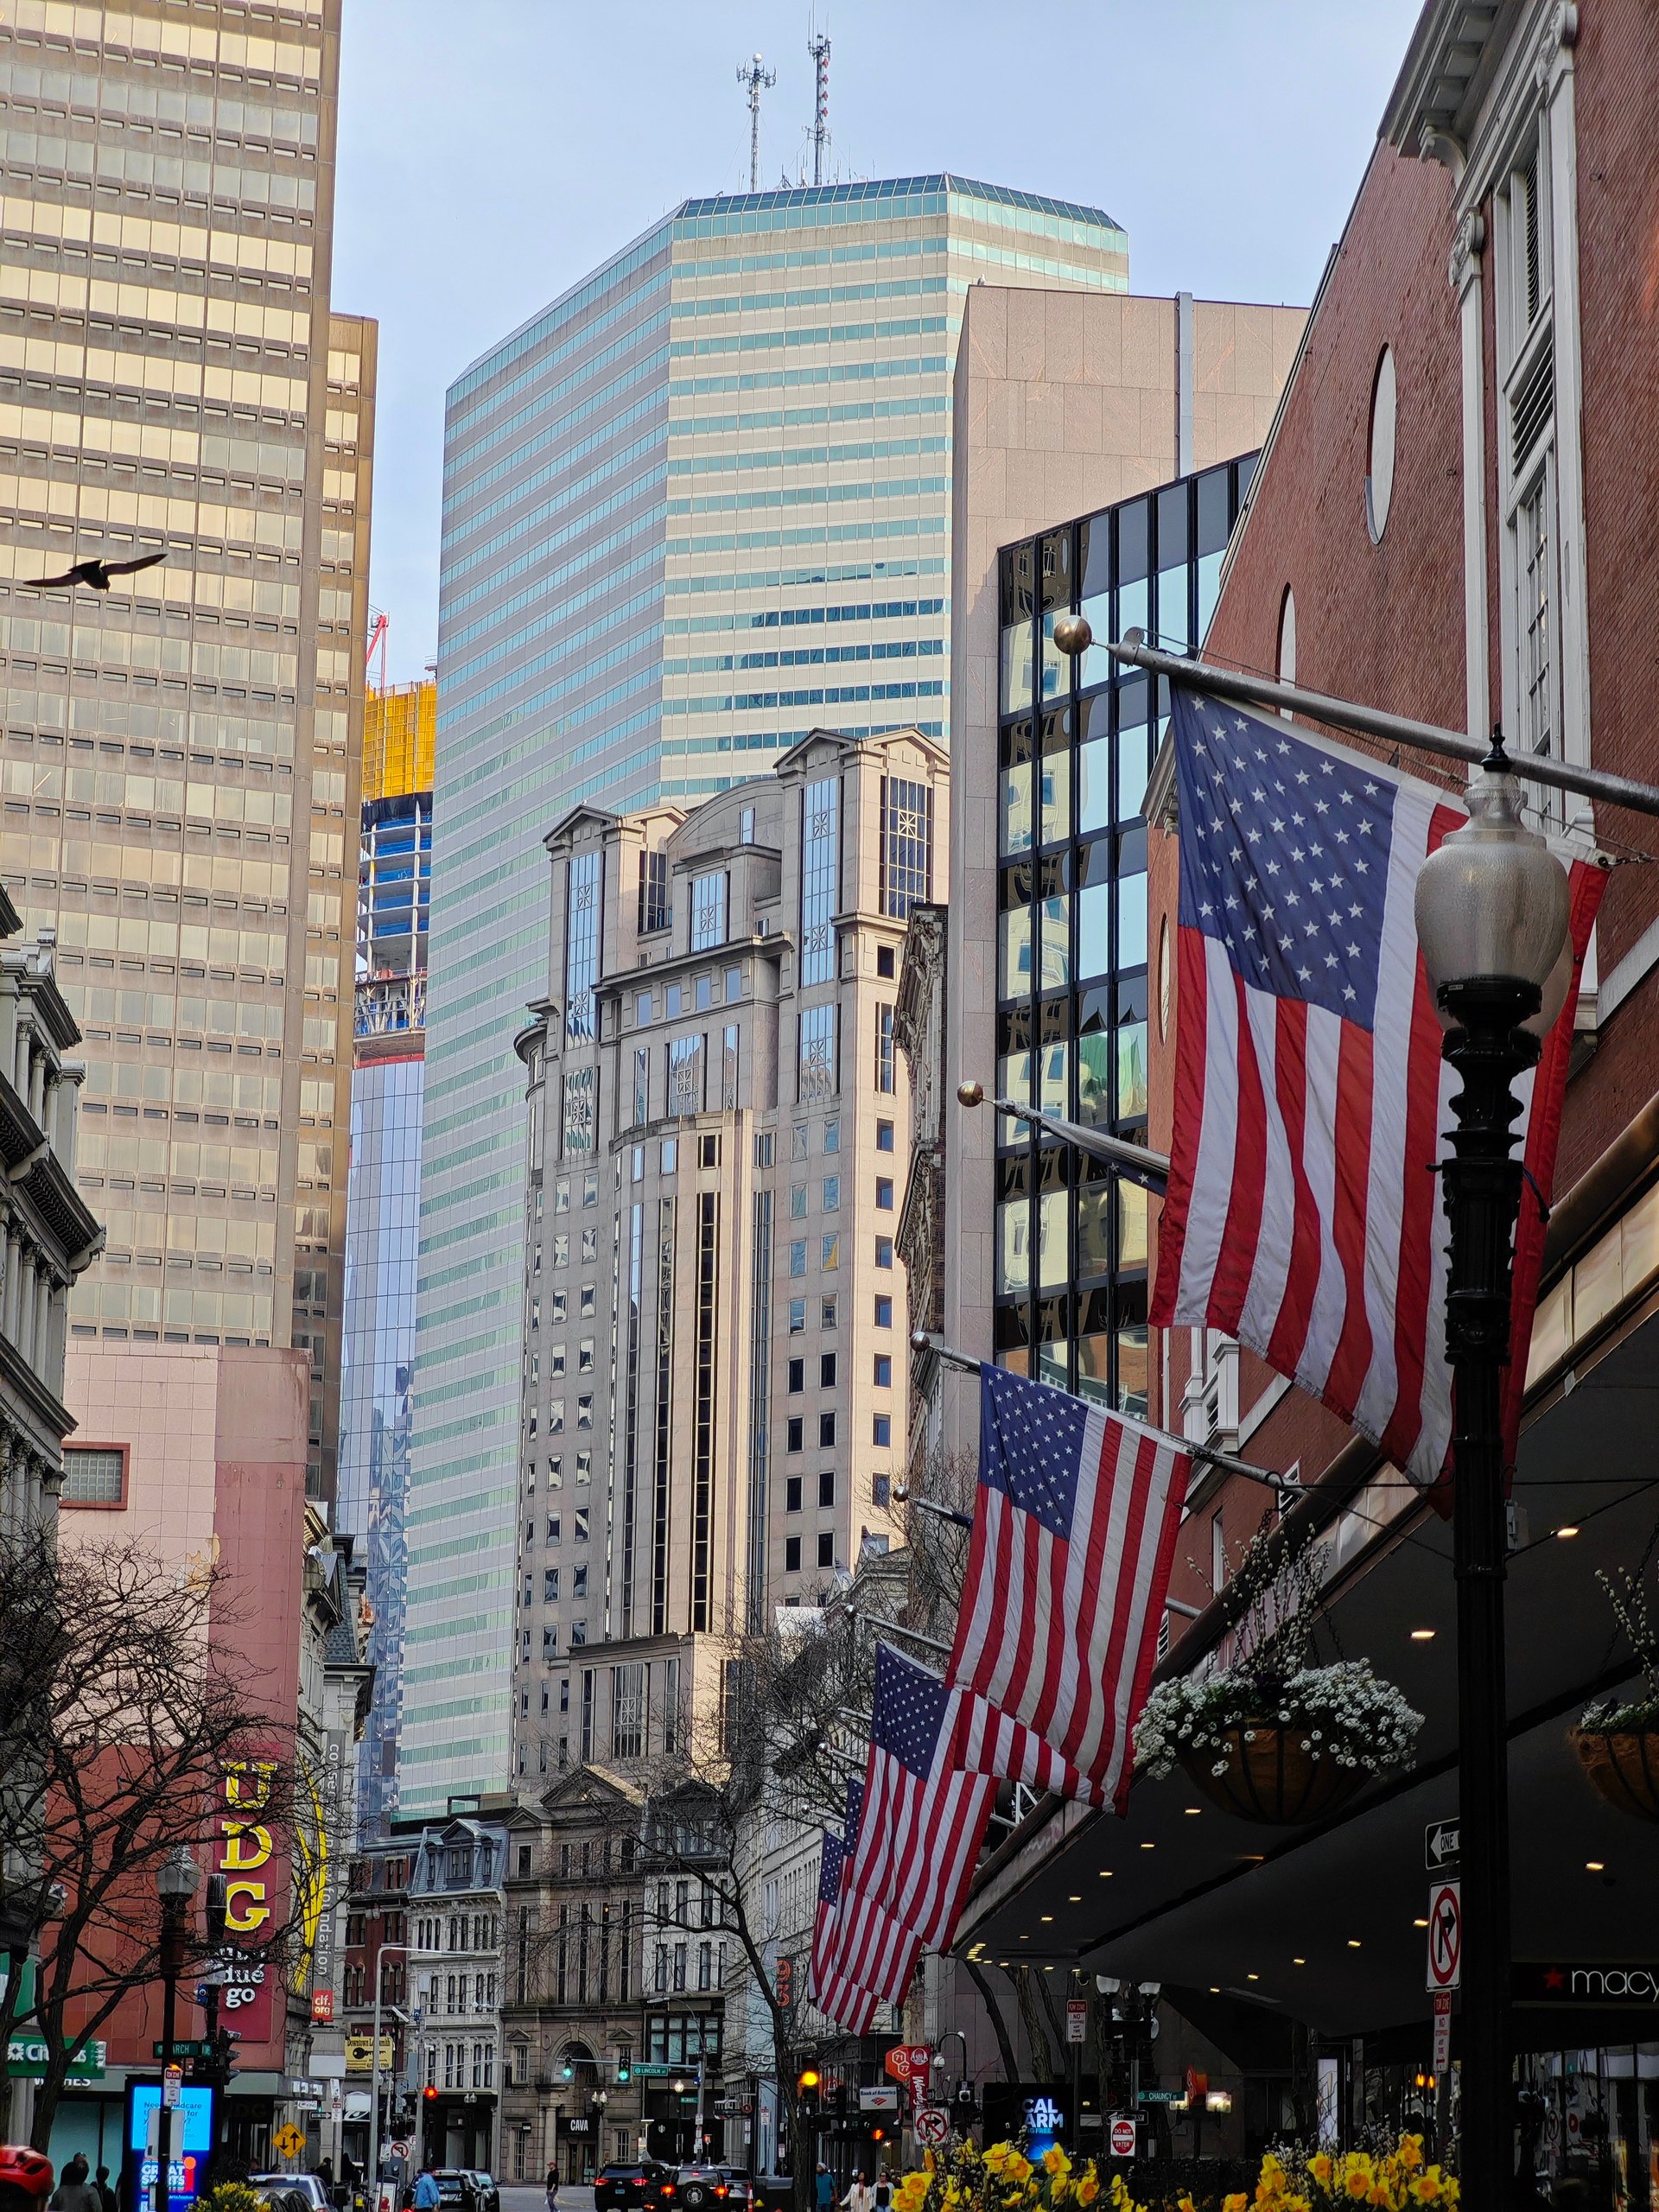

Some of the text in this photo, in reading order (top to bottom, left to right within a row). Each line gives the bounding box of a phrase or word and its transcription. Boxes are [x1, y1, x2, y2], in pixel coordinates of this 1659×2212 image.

[1440, 1834, 1454, 1852] ONE
[316, 1885, 335, 1975] foundation
[226, 1987, 256, 2008] go
[315, 1994, 331, 2005] clf.
[315, 2006, 330, 2016] org
[173, 2044, 189, 2055] RCH
[1148, 2092, 1173, 2101] CHAUNCY
[570, 2119, 588, 2131] CAVA
